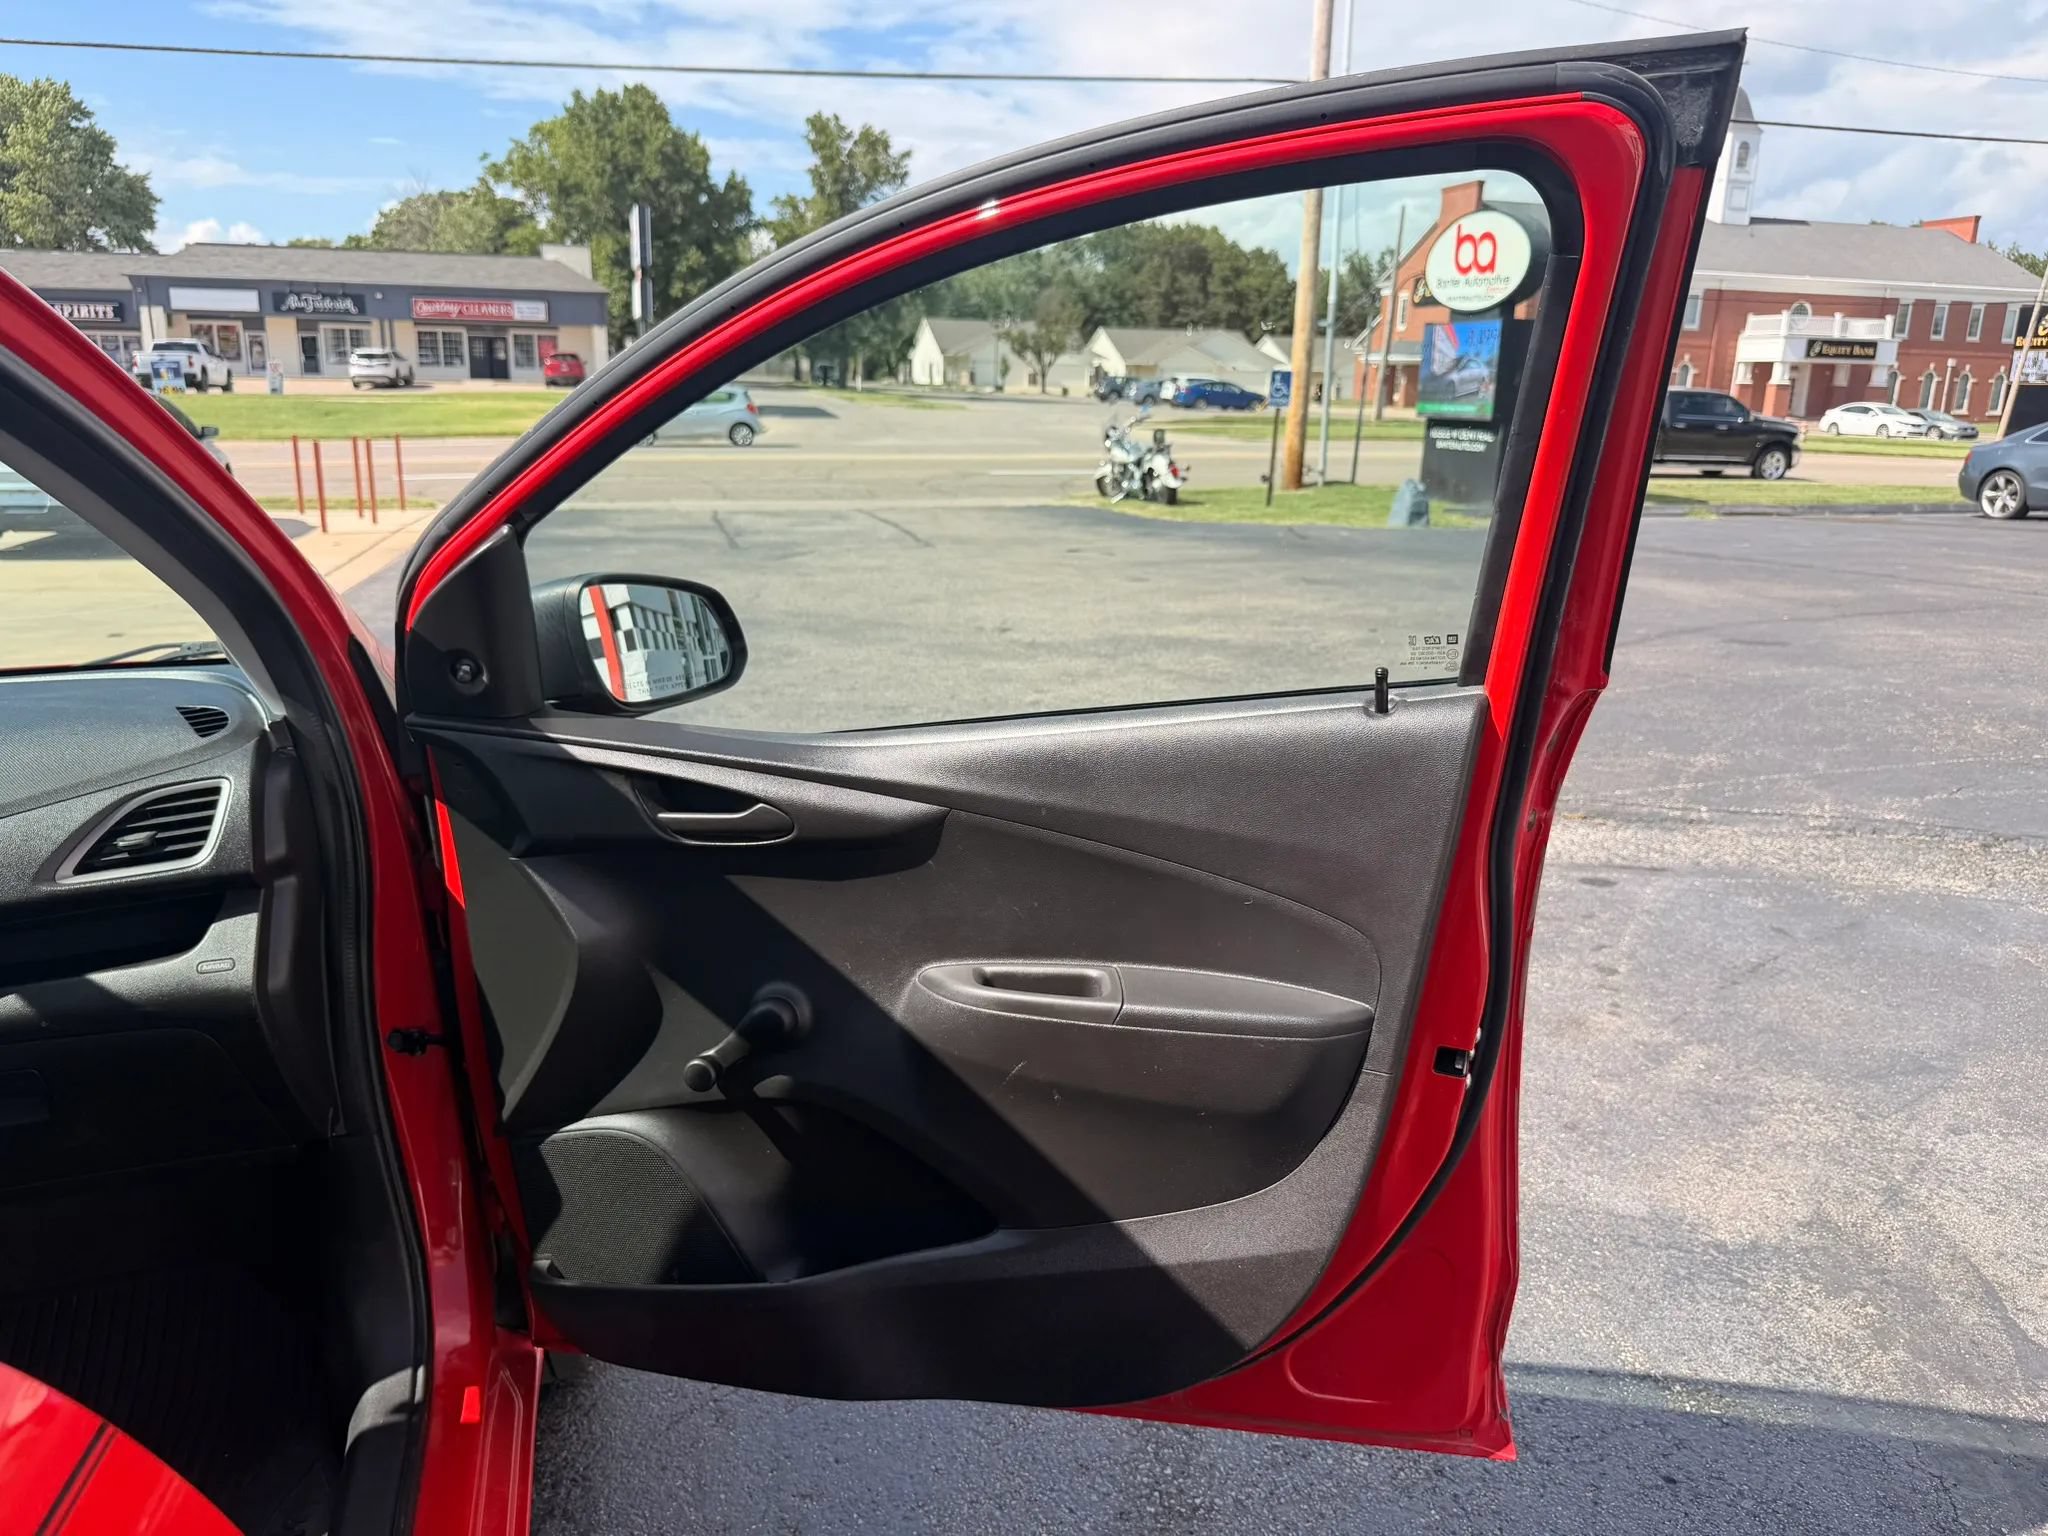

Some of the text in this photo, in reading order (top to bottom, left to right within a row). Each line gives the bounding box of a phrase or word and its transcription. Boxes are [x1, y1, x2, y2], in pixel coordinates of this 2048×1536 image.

[1464, 275, 1510, 287] Automotive
[462, 303, 513, 316] CLEANERS
[2016, 336, 2048, 347] EITY
